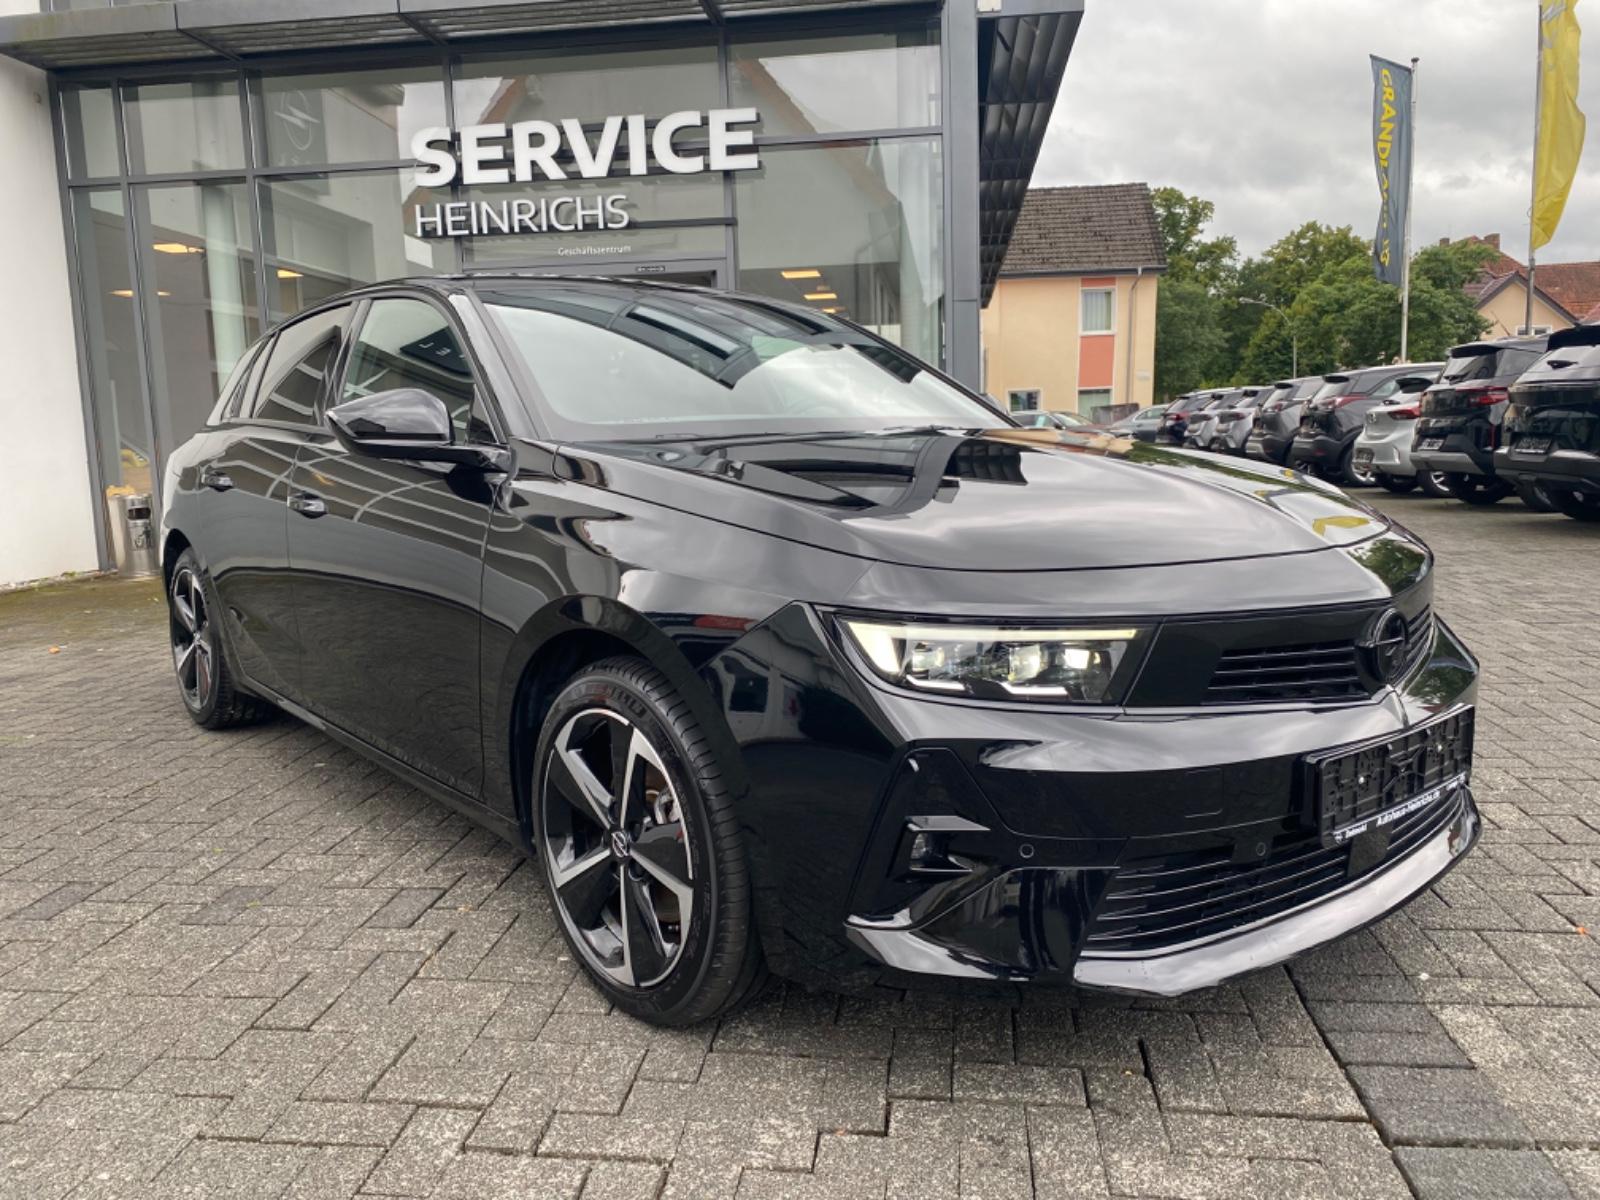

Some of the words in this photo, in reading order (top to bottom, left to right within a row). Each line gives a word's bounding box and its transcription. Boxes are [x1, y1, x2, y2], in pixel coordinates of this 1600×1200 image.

[410, 107, 760, 187] SERVICE
[414, 195, 630, 237] HEINRICHS
[557, 245, 632, 256] Geschäftszentrum
